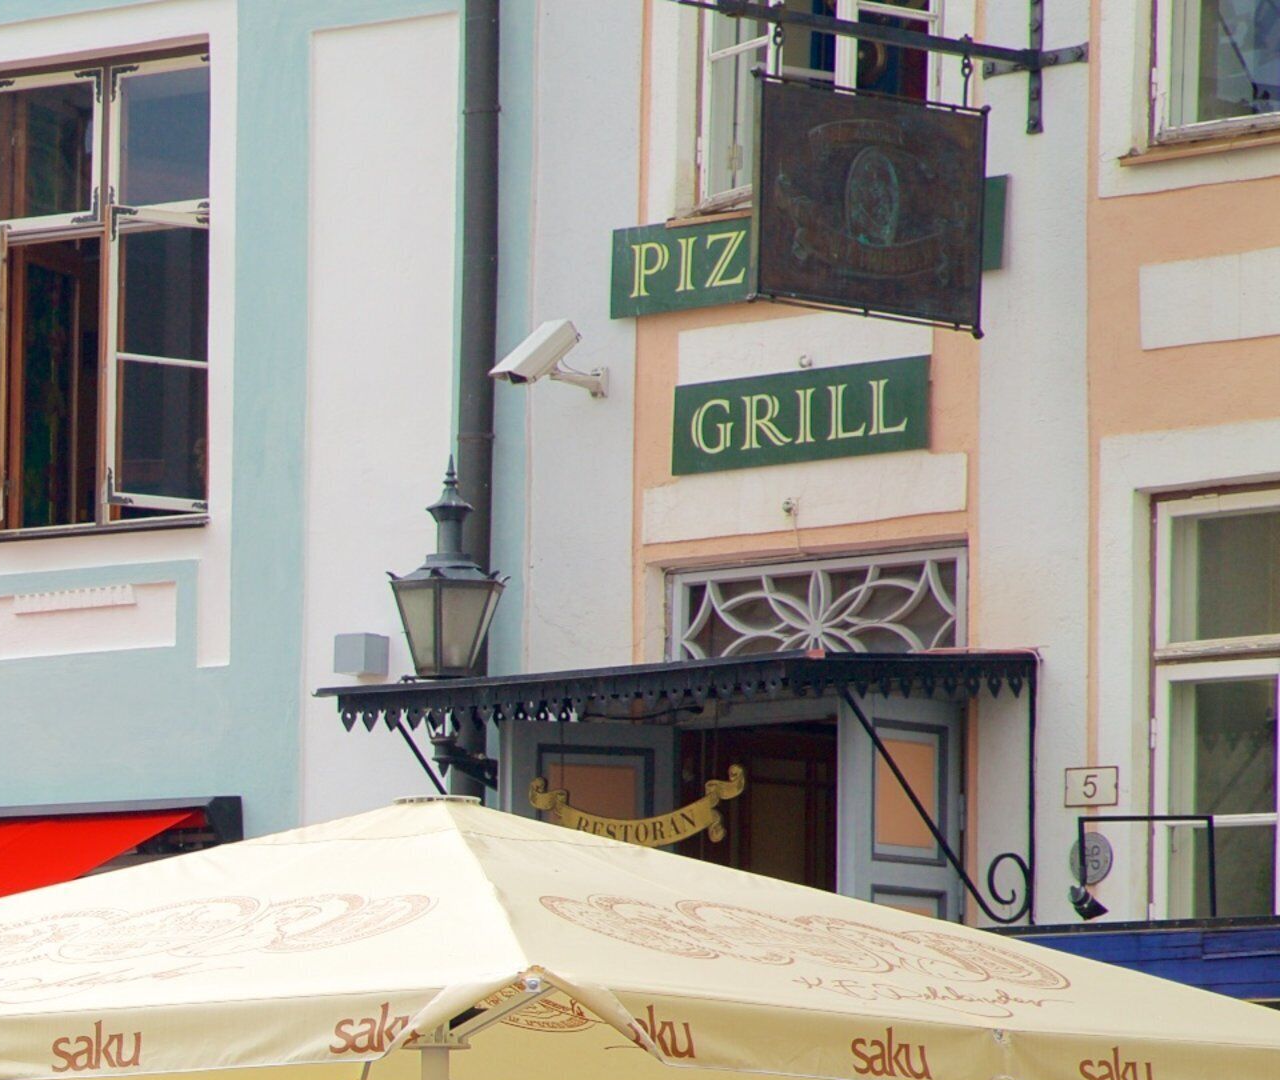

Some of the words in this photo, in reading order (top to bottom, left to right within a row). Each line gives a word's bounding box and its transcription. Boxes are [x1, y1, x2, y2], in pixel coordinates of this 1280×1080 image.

[629, 230, 747, 299] PIZ
[691, 379, 908, 454] GRILL
[1083, 774, 1098, 798] 5
[51, 1020, 141, 1073] saku
[851, 1027, 932, 1080] saku
